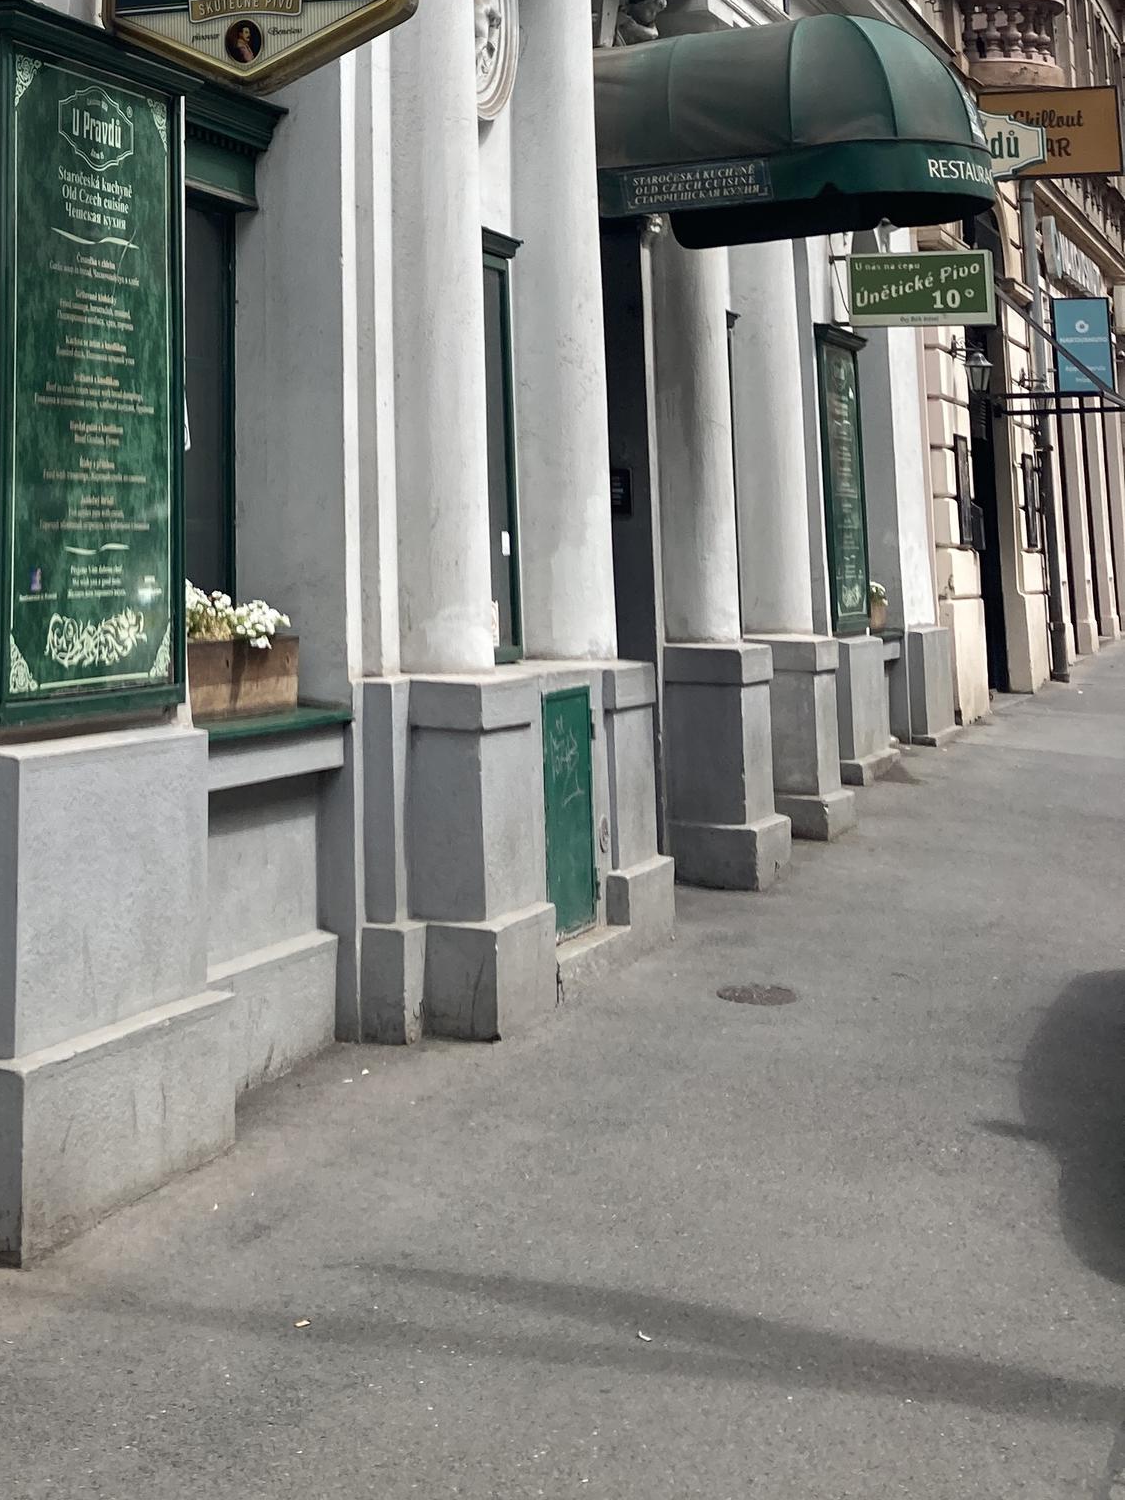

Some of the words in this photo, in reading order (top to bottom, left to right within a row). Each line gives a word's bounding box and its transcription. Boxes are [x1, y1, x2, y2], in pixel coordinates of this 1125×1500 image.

[72, 107, 80, 136] U
[83, 110, 122, 149] Pravdů
[62, 184, 77, 200] Old
[79, 188, 102, 207] Czech
[635, 185, 659, 196] OLD
[662, 180, 703, 192] CZECH
[855, 261, 863, 270] U
[855, 271, 934, 308] Únětické
[940, 262, 980, 283] Pivo
